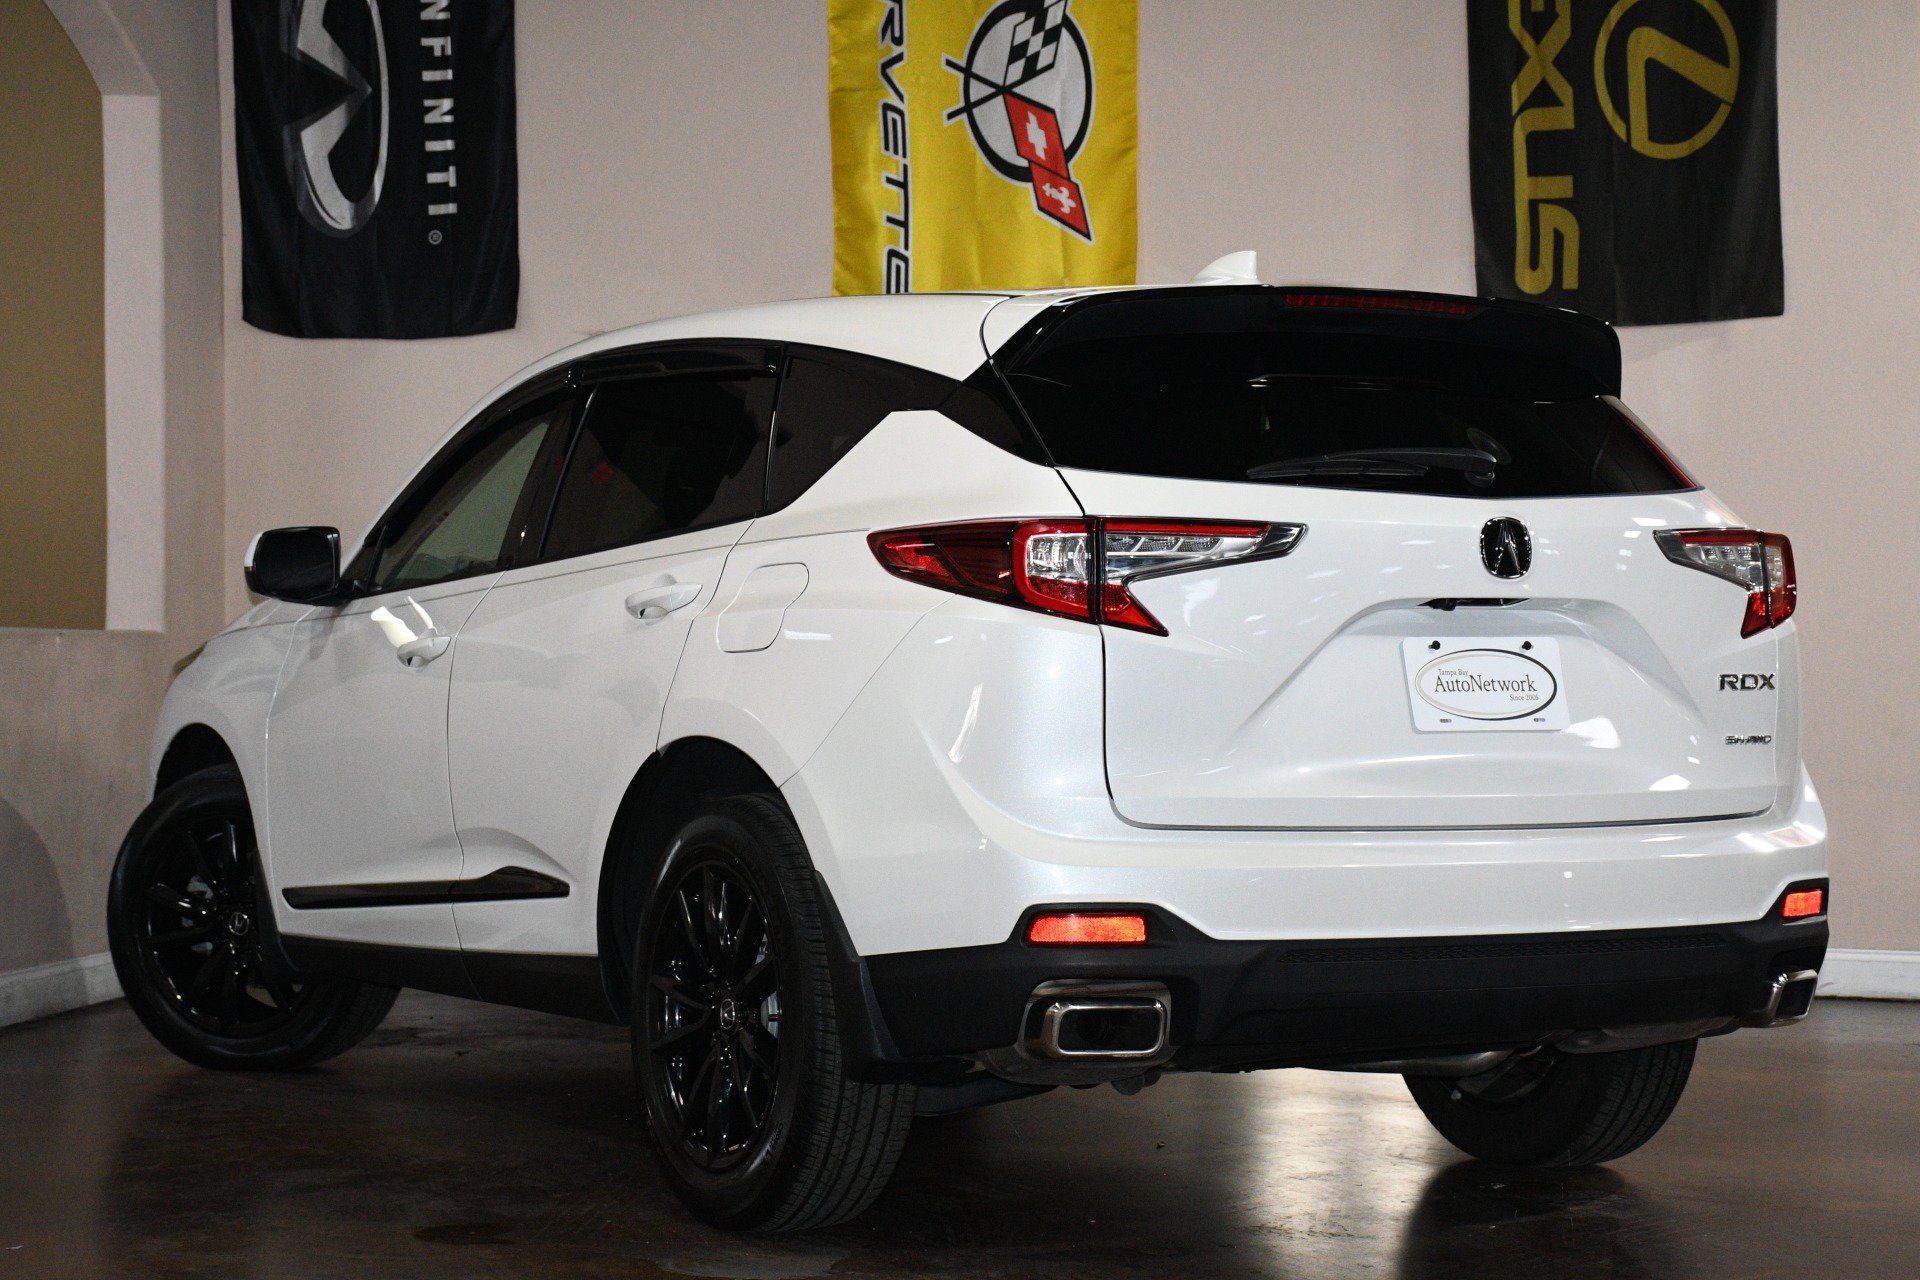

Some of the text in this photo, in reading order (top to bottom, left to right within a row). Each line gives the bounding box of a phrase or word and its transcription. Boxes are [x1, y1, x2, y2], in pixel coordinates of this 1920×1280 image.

[1507, 0, 1580, 295] XUS
[1438, 668, 1469, 678] Tampa Bay
[1718, 673, 1776, 692] RDX
[1434, 673, 1538, 693] AutoNetwork
[1509, 694, 1525, 702] Since
